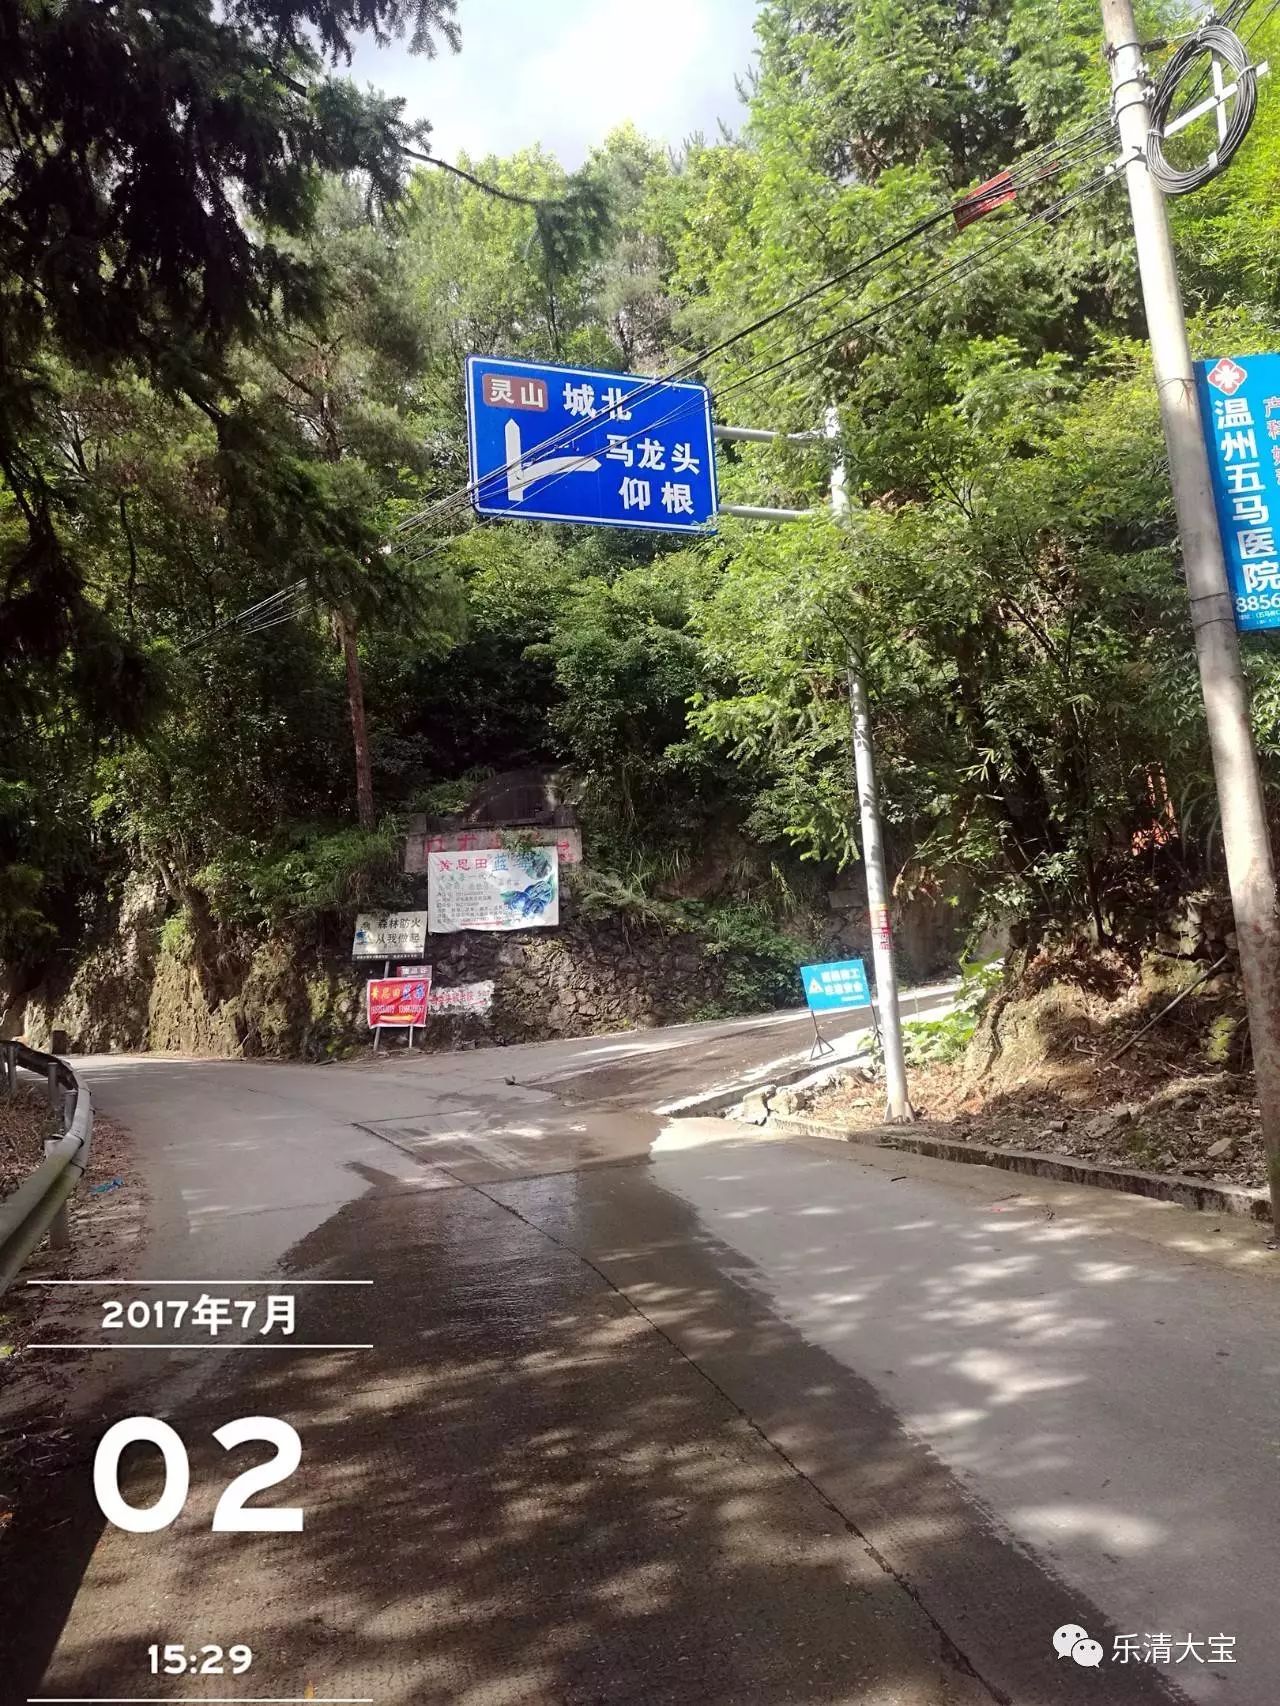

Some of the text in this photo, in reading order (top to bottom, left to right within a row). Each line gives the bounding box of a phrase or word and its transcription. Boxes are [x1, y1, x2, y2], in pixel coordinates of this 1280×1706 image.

[490, 378, 544, 408] 灵山
[562, 382, 632, 421] 城北
[605, 433, 701, 475] 马龙头
[618, 476, 695, 515] 仰根
[1214, 397, 1280, 594] 温州五马医院
[375, 932, 421, 945] 从我做起
[376, 916, 422, 930] 森林防火
